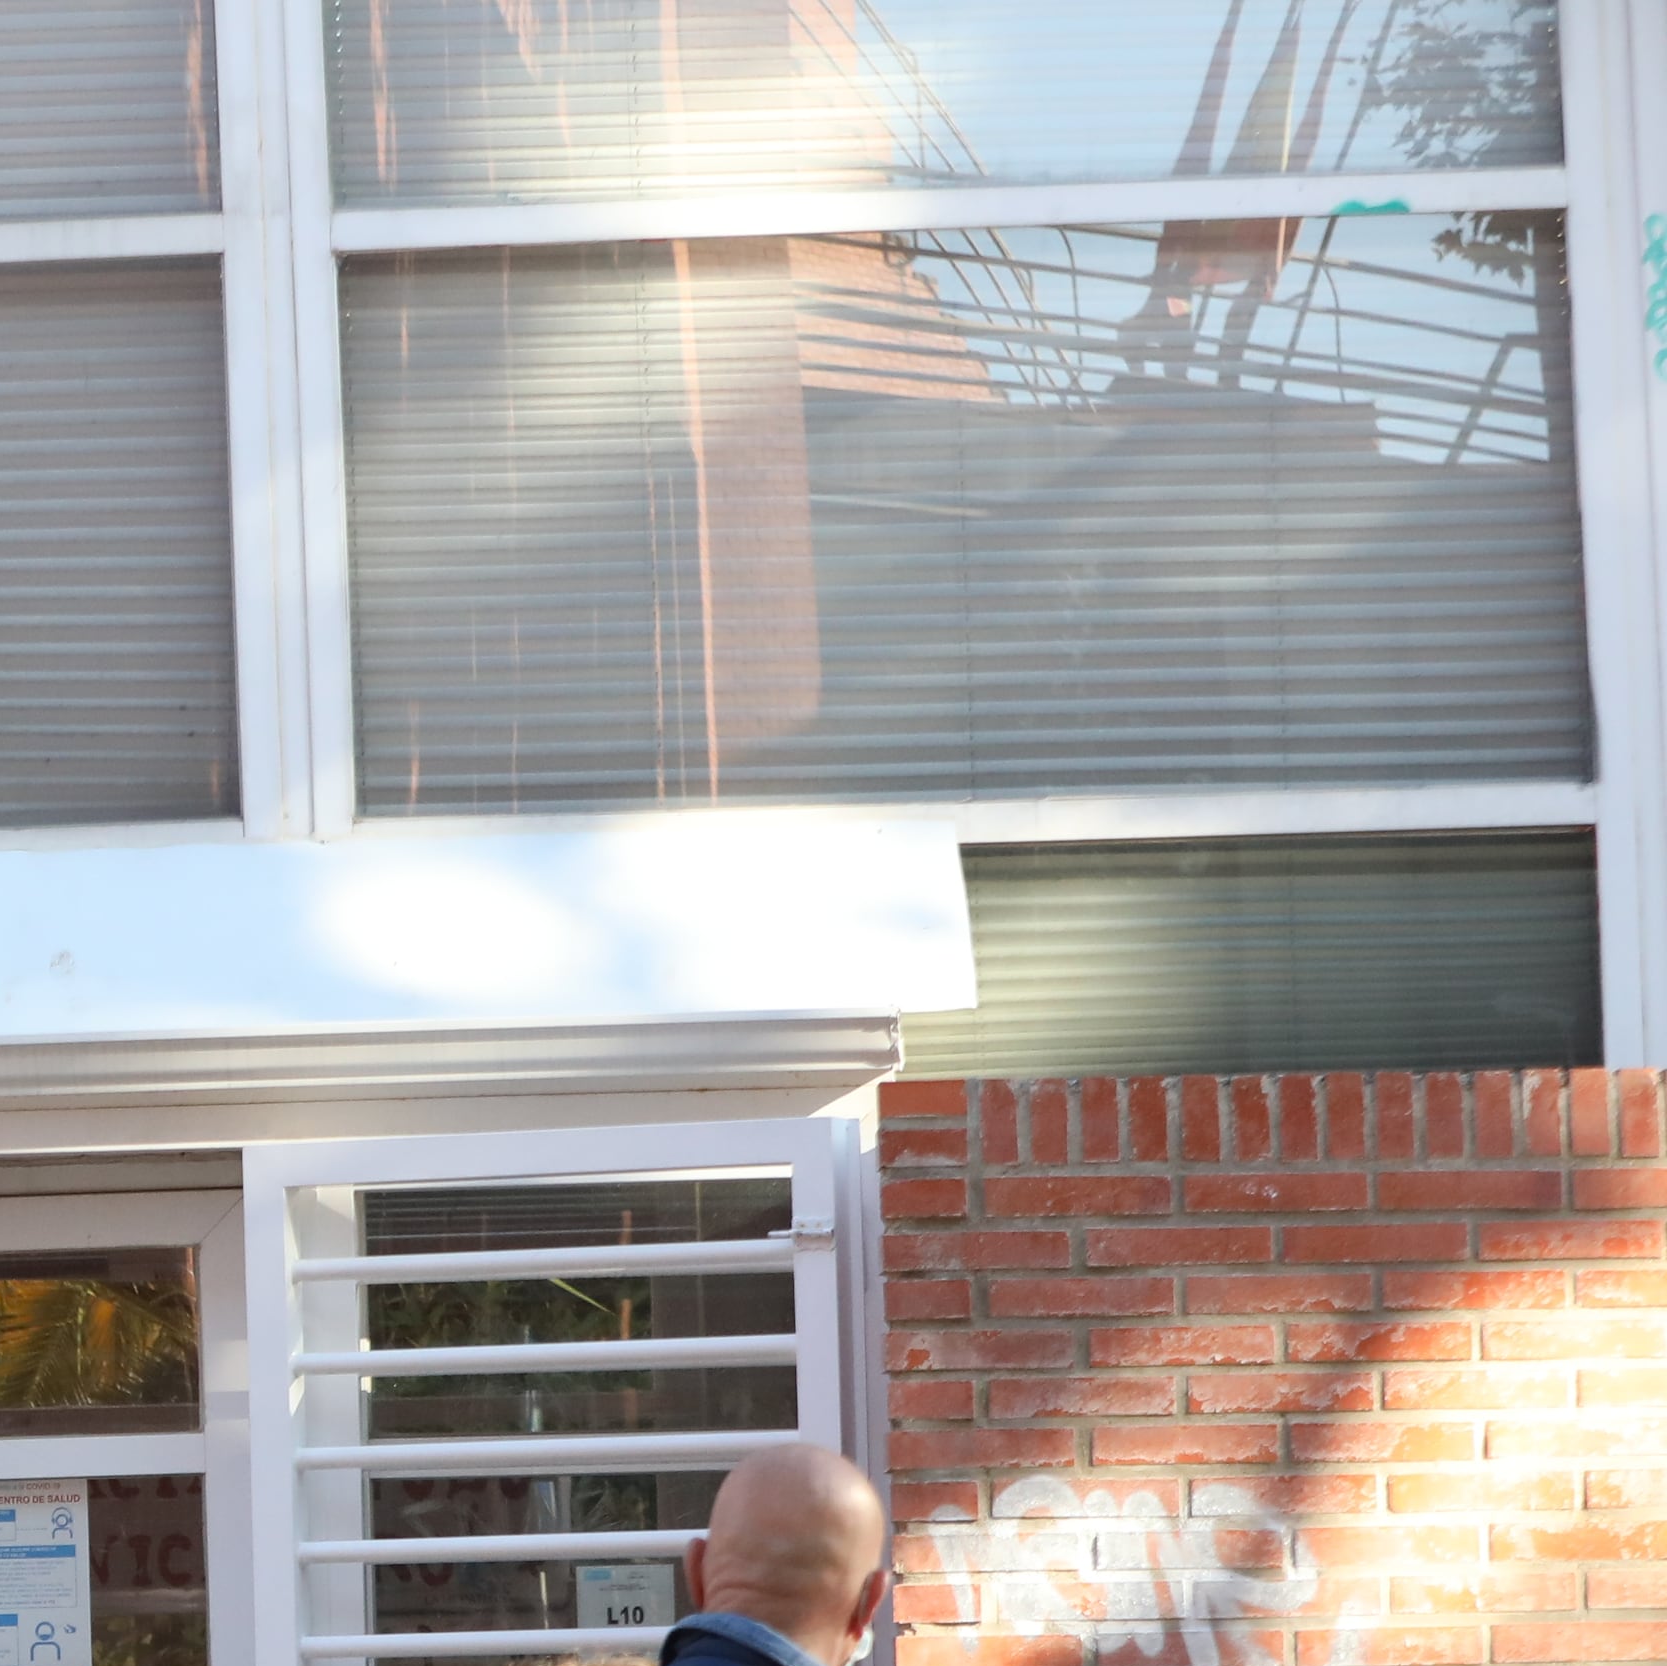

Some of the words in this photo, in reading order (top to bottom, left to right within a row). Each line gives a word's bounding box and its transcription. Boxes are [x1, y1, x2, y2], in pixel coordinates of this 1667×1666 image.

[32, 1495, 45, 1504] DE
[47, 1494, 81, 1504] SALUD
[607, 1606, 644, 1625] L10
